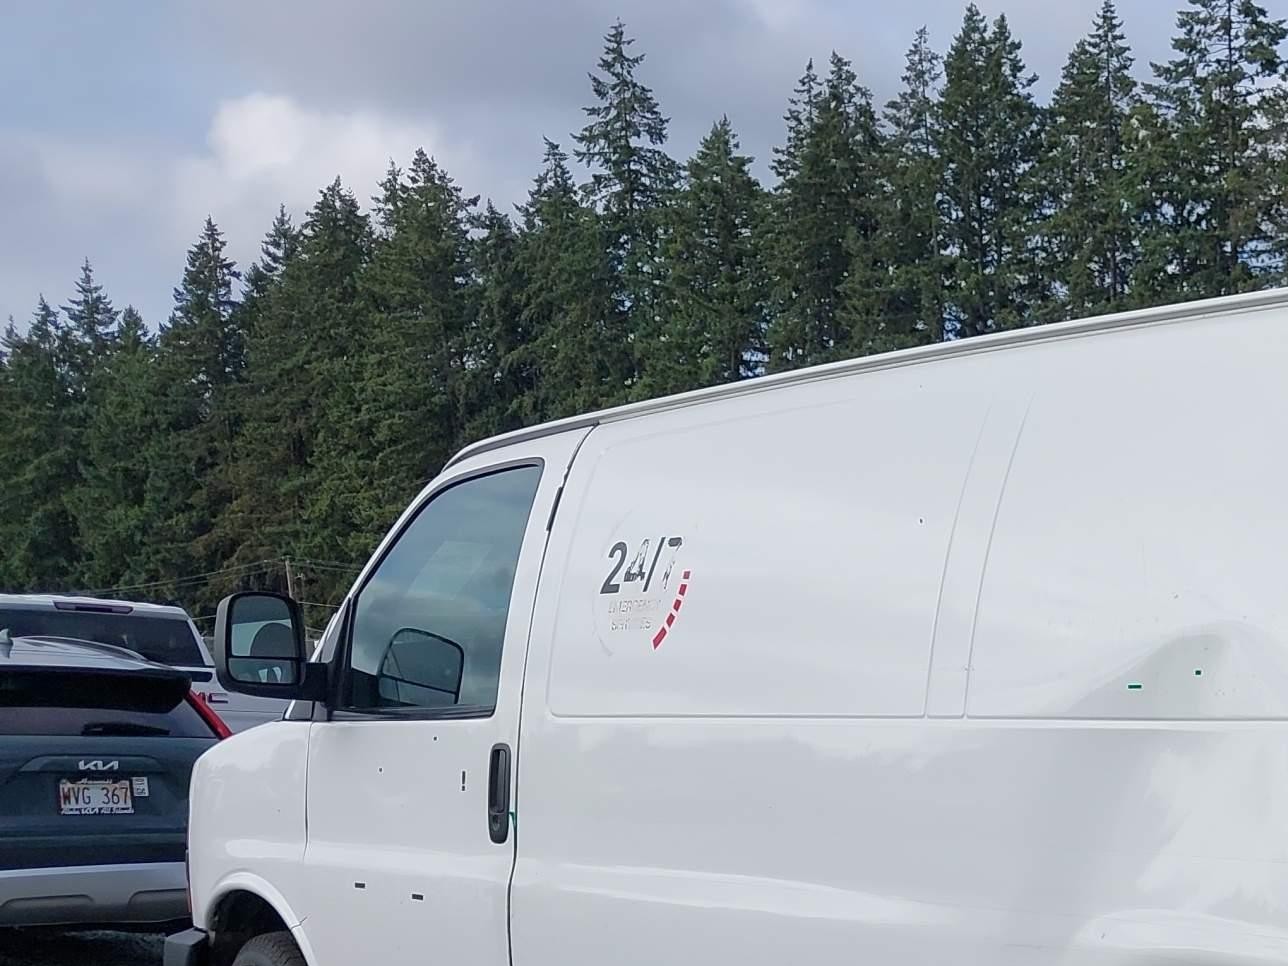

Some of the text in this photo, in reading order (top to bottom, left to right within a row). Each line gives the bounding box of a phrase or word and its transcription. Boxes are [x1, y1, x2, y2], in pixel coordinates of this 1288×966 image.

[78, 760, 119, 770] KIA
[62, 786, 128, 805] WVG 367
